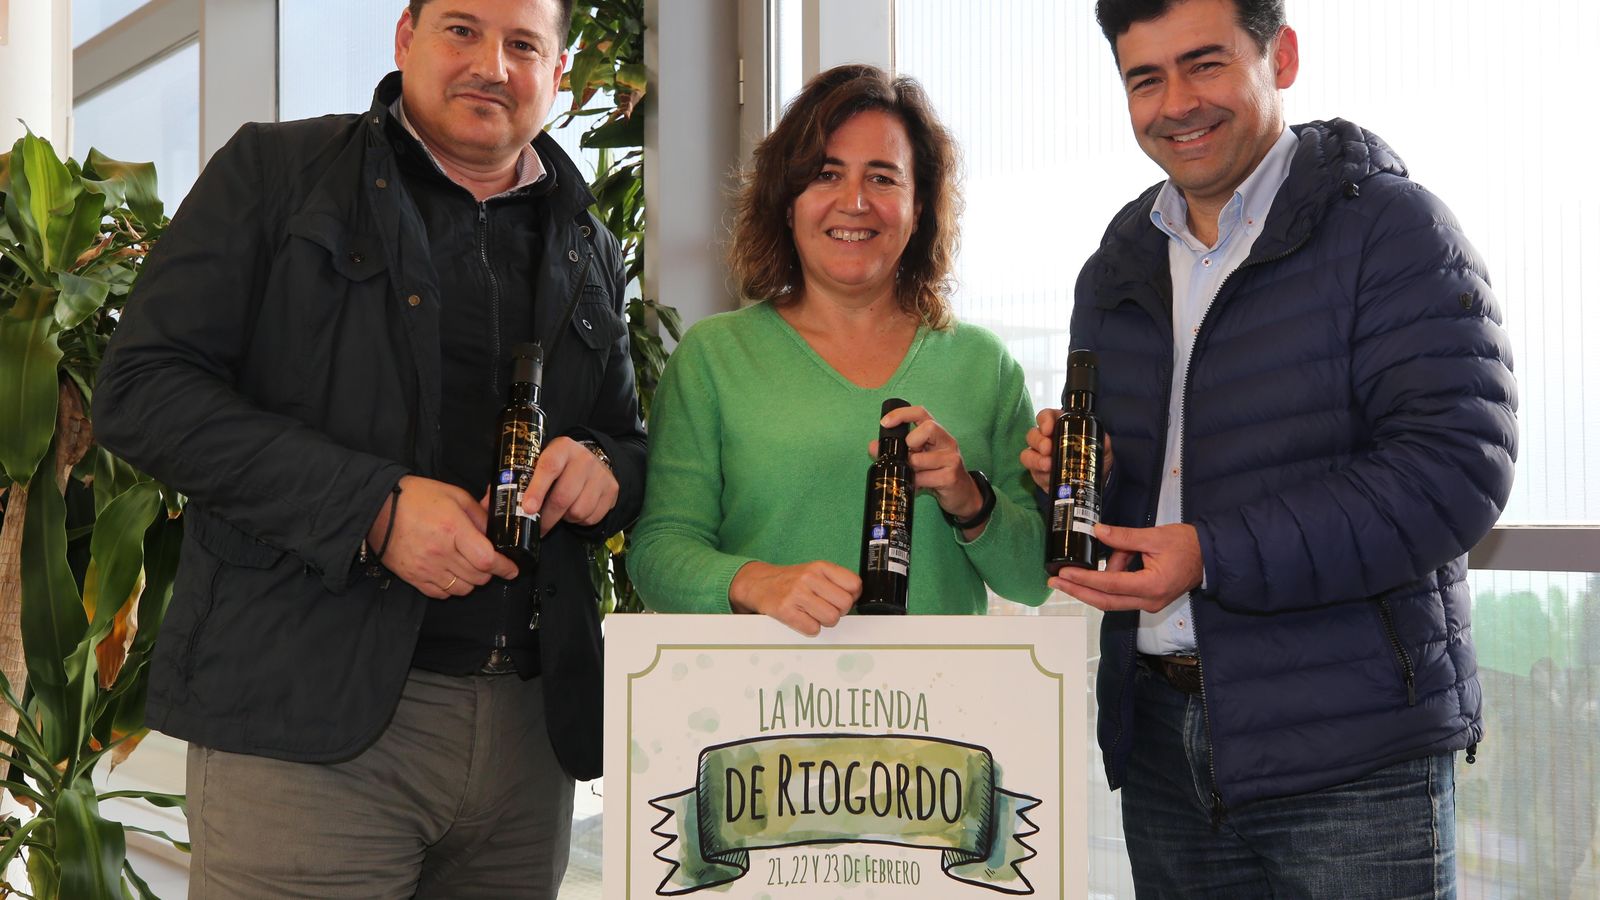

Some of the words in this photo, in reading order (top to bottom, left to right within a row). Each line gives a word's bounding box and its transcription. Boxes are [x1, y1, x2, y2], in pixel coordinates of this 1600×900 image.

[759, 688, 786, 732] LA
[794, 683, 929, 732] MOLIENDA
[726, 765, 765, 822] DE
[778, 754, 962, 824] RIOGORDO
[812, 854, 819, 883] Y
[823, 854, 840, 883] 23
[865, 854, 921, 886] FEBRERO
